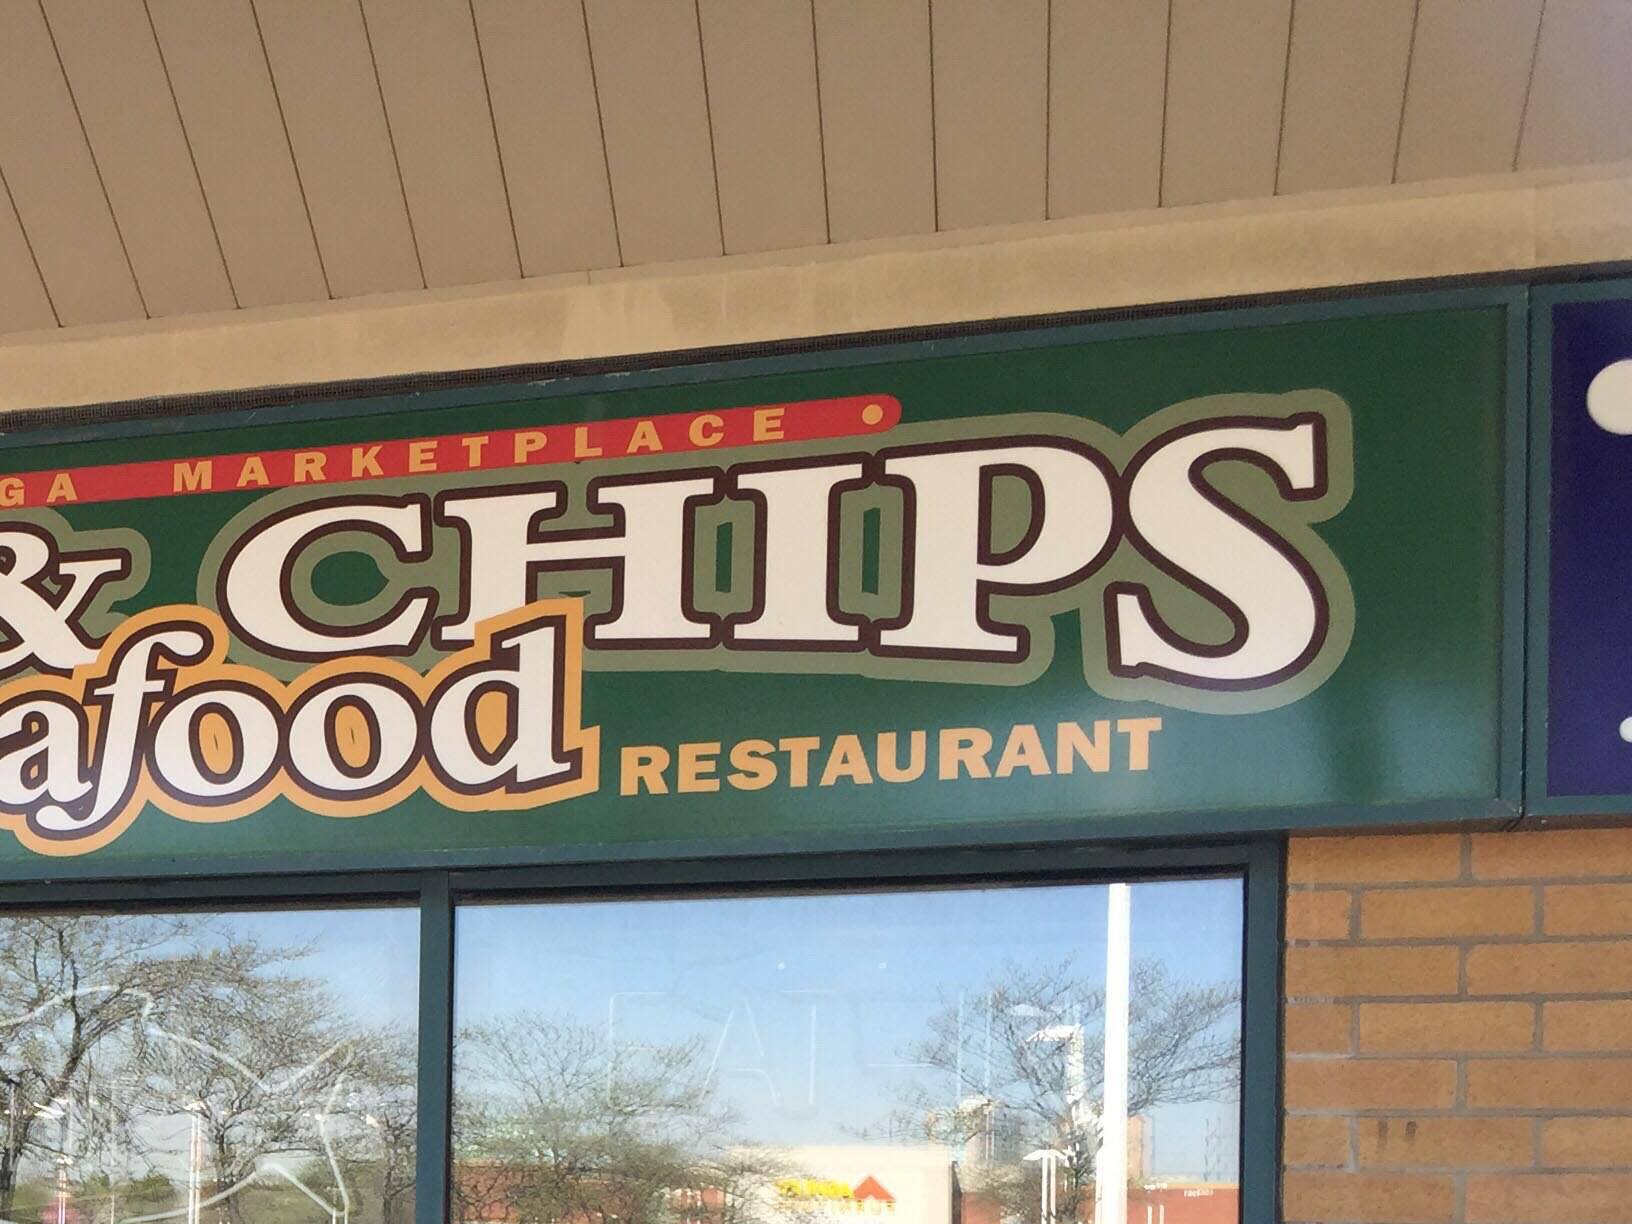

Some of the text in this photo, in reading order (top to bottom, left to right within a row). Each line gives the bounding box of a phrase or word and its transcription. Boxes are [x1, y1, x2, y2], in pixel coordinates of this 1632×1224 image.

[172, 407, 785, 493] MARKETPLACE
[216, 411, 1328, 691] CHIPS
[618, 716, 1164, 797] RESTAURANT
